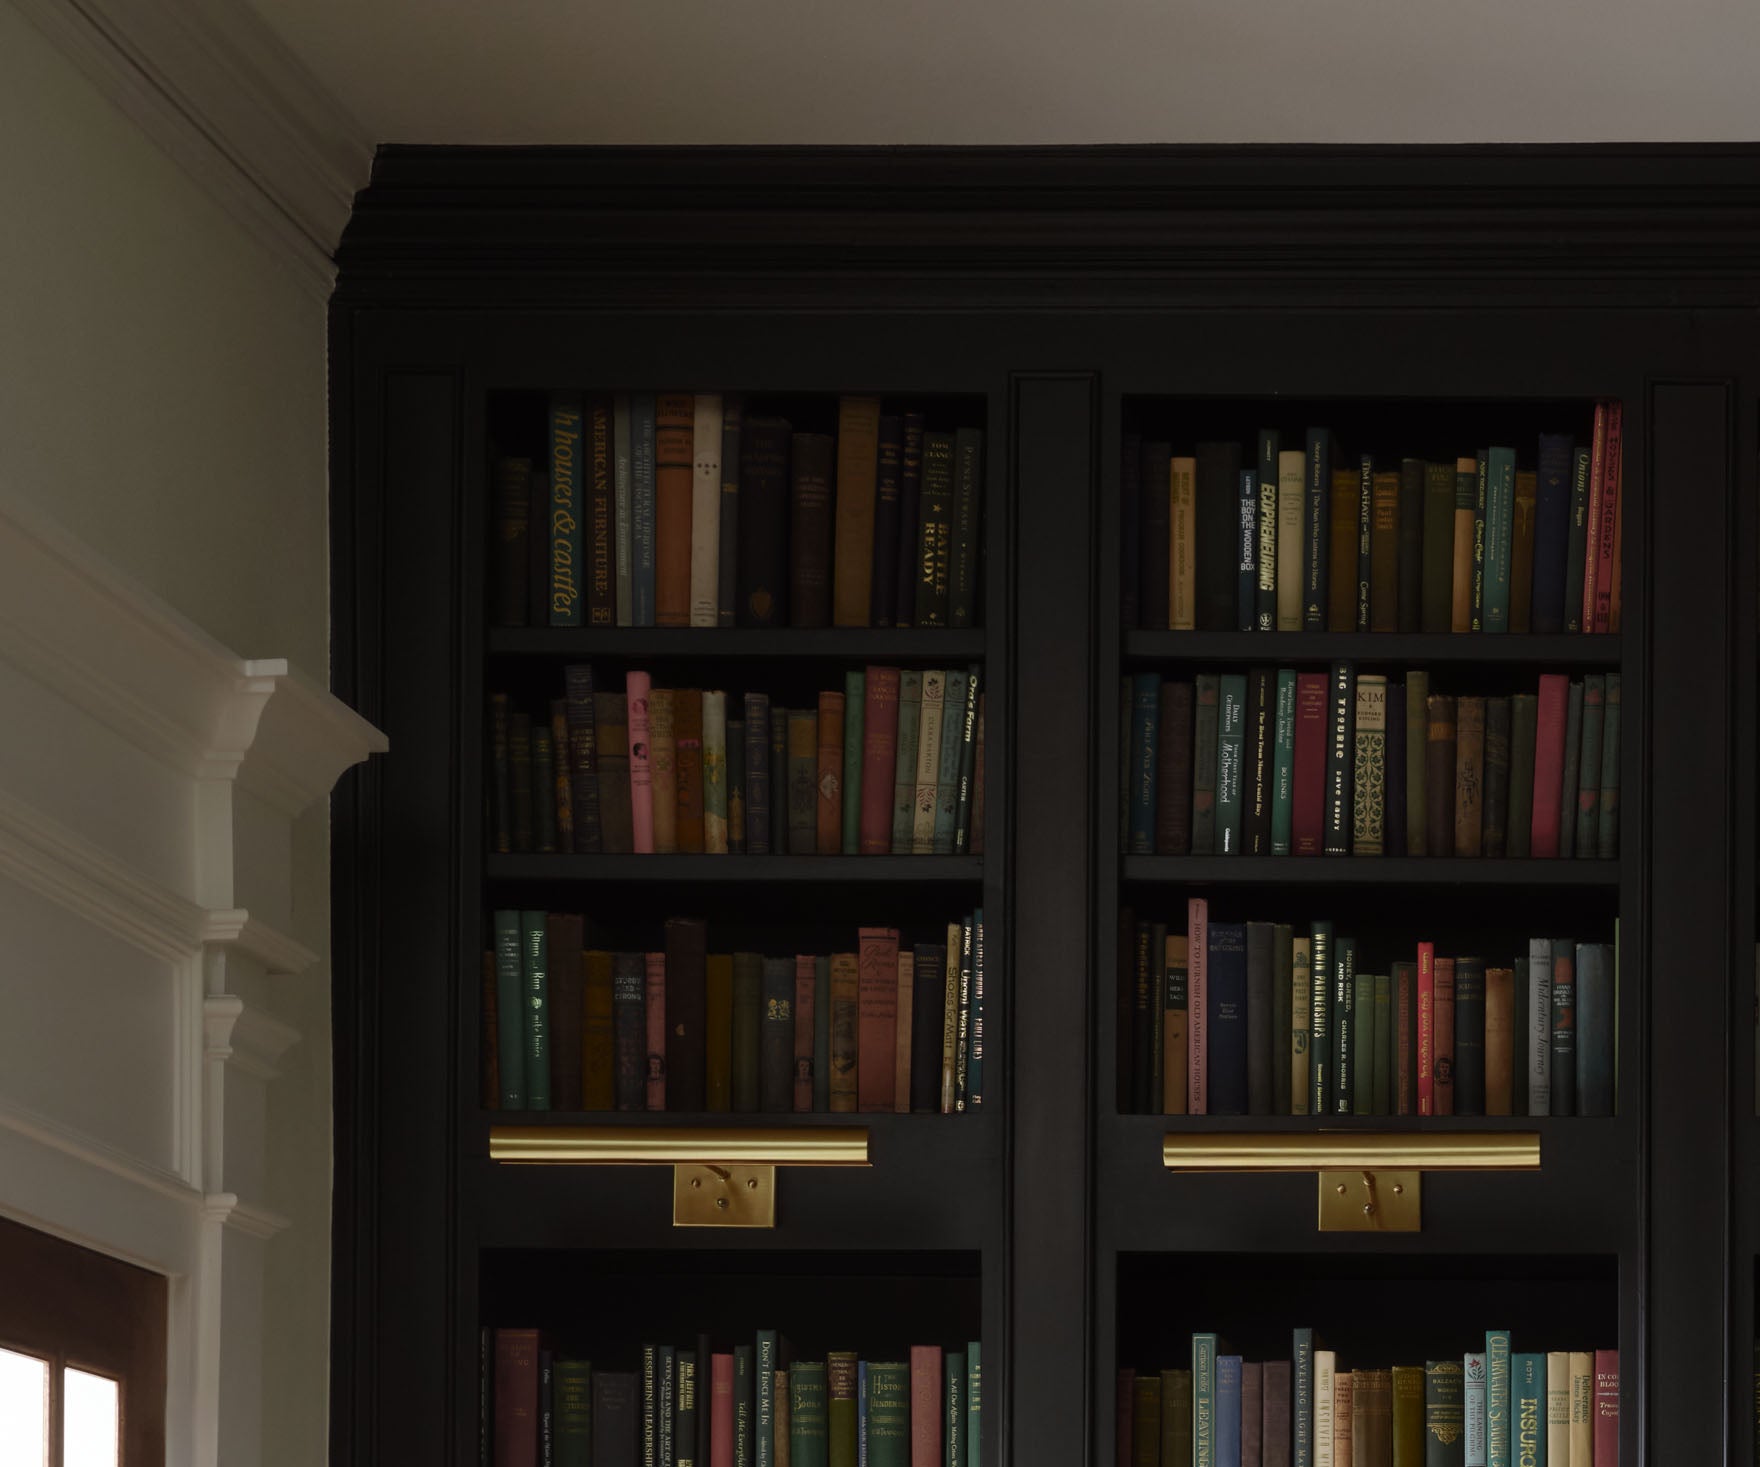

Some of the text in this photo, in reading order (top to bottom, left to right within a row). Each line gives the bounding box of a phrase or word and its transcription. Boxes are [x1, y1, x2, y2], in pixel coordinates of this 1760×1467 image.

[1241, 499, 1255, 507] THE
[553, 429, 578, 616] houses & castles
[1242, 521, 1255, 529] THE
[1259, 484, 1275, 591] ECOPRENEURING
[1243, 529, 1252, 563] WOODEN
[1241, 562, 1255, 571] BOX
[1358, 690, 1385, 704] KIM
[1220, 741, 1232, 803] Motherhood
[761, 1341, 770, 1424] DON'T FENCE ME IN
[1299, 1343, 1308, 1444] TRAVELING LIGHT
[1582, 1375, 1590, 1423] Deliverance
[737, 1419, 745, 1433] Me
[665, 1453, 671, 1461] OF
